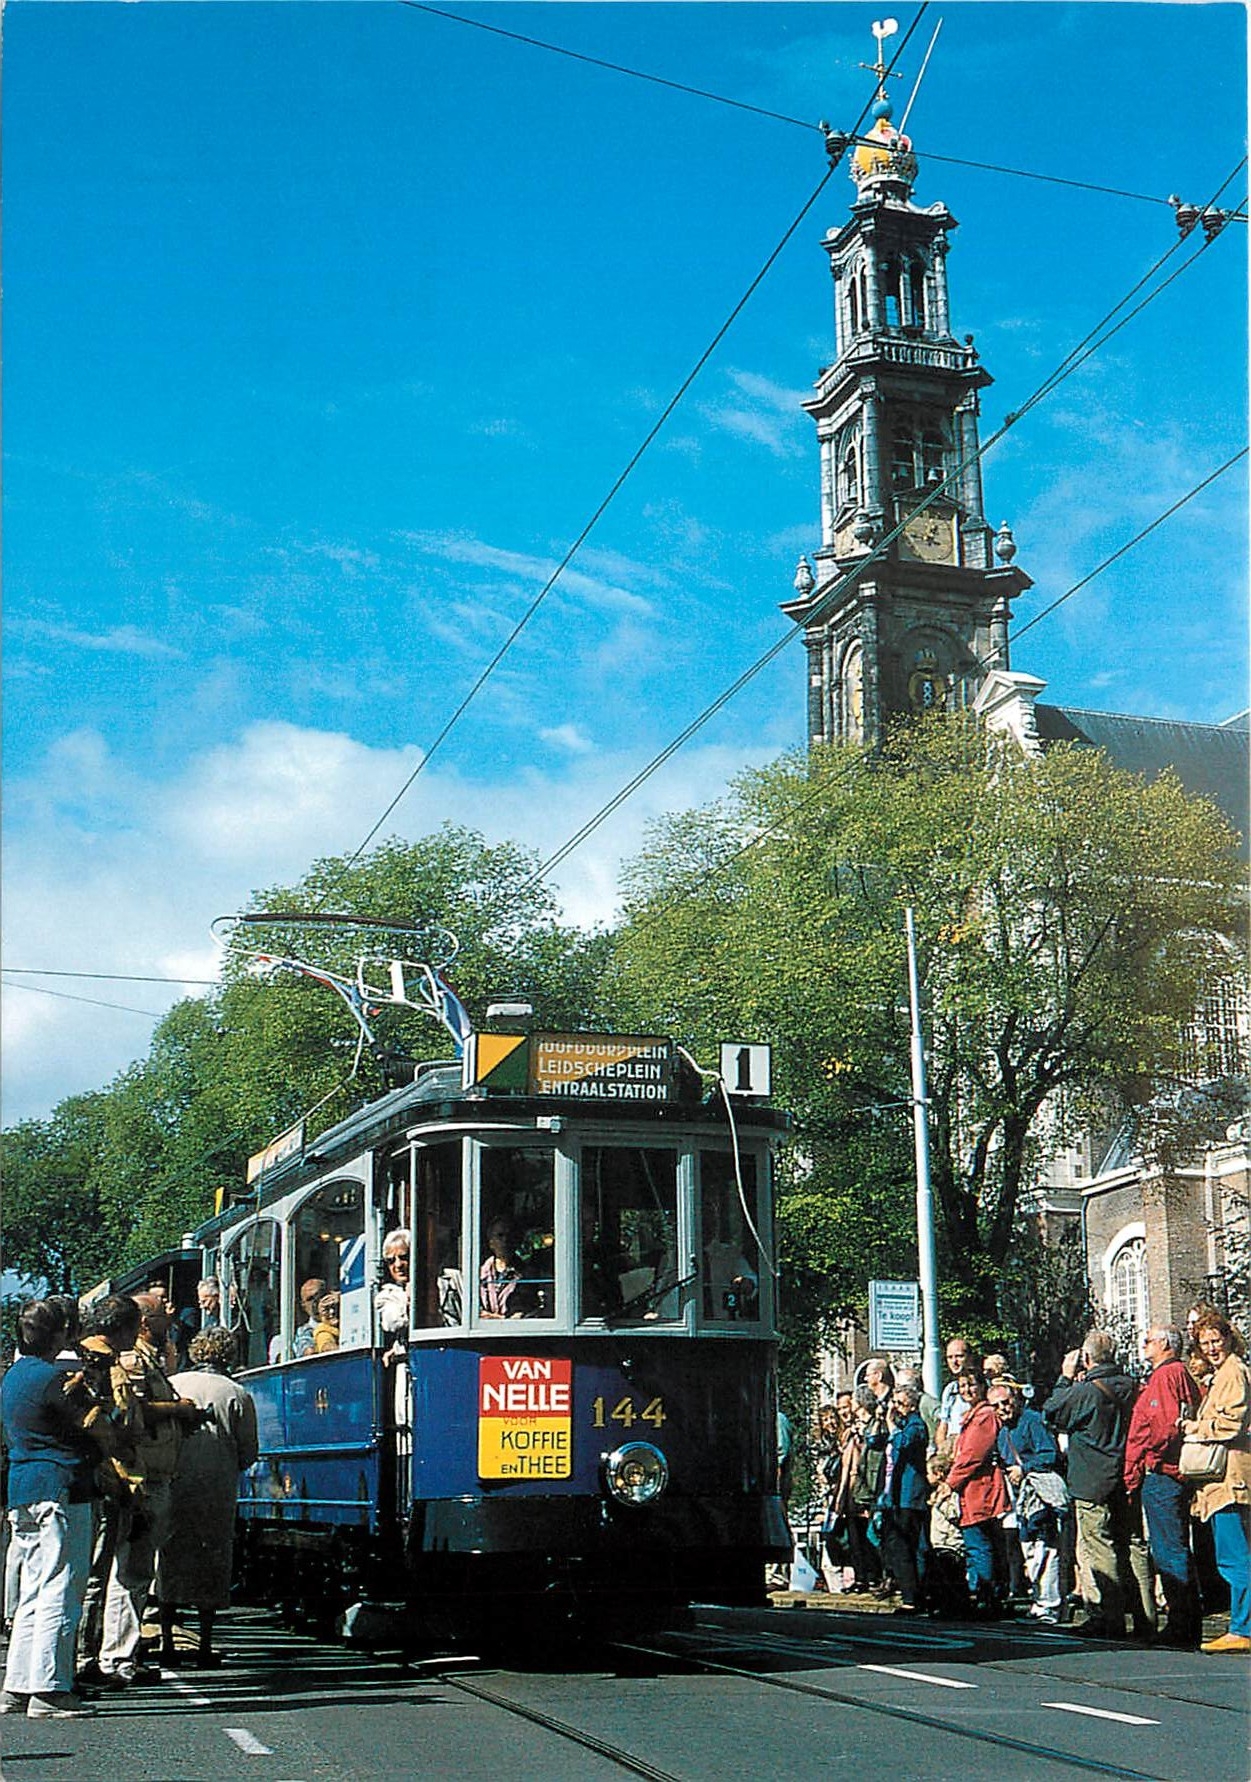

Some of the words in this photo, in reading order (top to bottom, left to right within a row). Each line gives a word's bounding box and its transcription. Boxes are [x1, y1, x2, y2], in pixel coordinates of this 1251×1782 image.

[540, 1057, 661, 1079] LEIDSCHEPLEIN
[735, 1048, 753, 1091] 1
[538, 1079, 667, 1099] ENTRAALSTATION
[502, 1360, 552, 1380] VAN
[482, 1383, 570, 1411] NELLE
[592, 1396, 667, 1429] 144
[501, 1431, 567, 1450] KOFFIE
[518, 1455, 567, 1474] THEE
